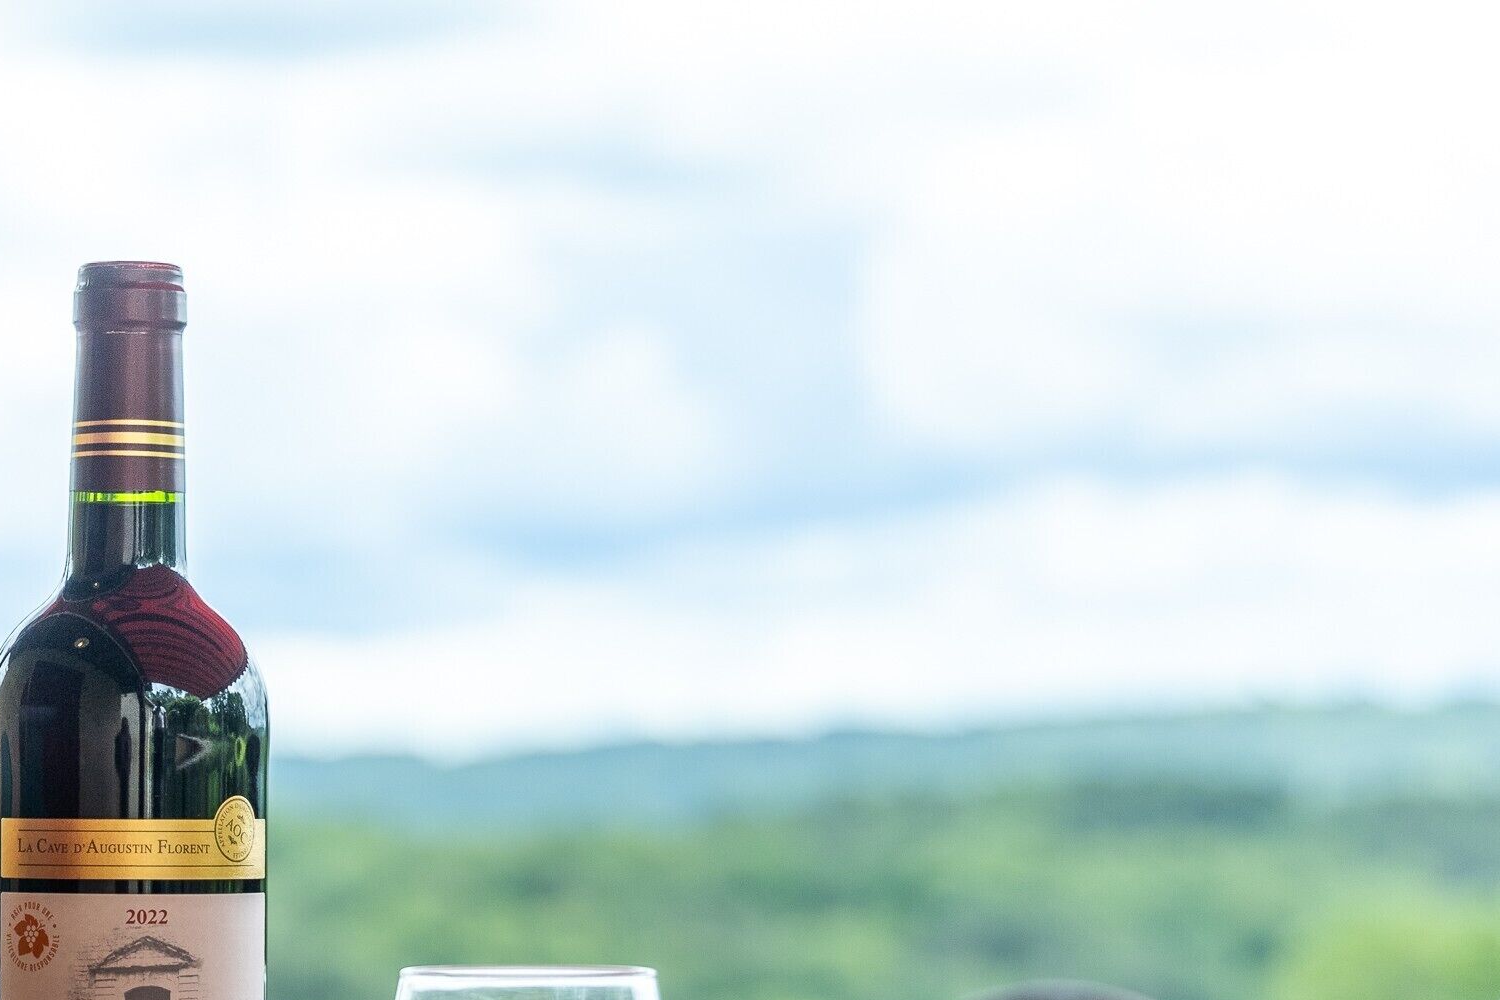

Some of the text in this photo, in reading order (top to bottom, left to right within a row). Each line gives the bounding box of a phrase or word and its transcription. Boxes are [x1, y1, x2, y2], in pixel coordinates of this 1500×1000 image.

[225, 818, 249, 845] AOC
[36, 838, 68, 854] CAVE
[157, 839, 211, 855] FLORENT
[24, 901, 40, 911] POUR
[41, 907, 55, 920] UNE
[125, 909, 169, 924] 2022
[29, 934, 60, 972] RESPONSABLE
